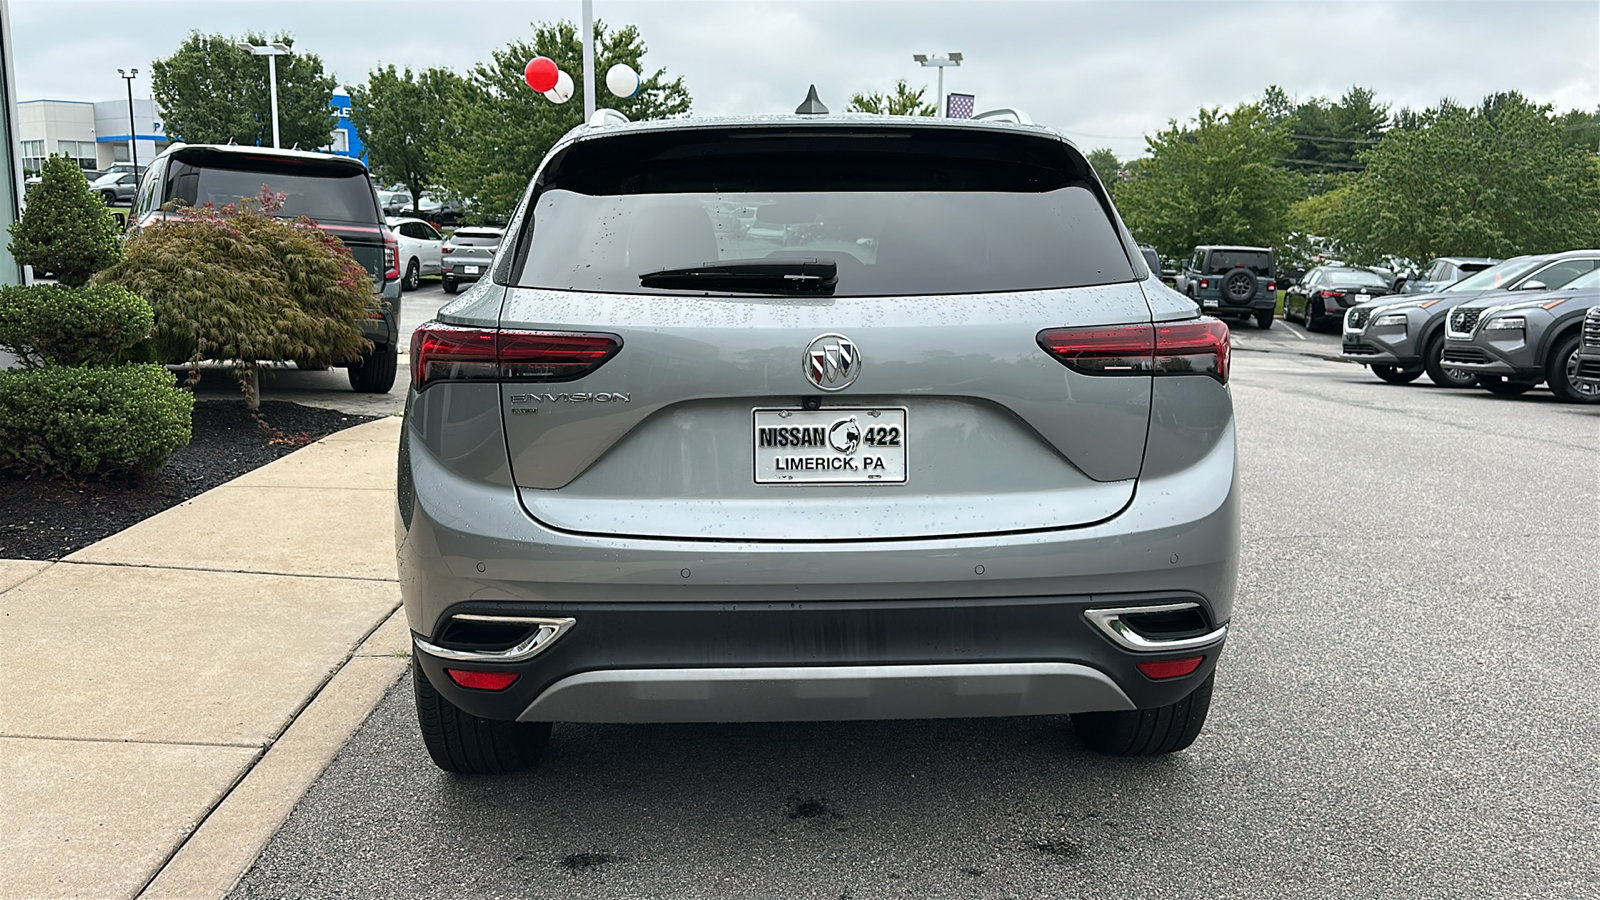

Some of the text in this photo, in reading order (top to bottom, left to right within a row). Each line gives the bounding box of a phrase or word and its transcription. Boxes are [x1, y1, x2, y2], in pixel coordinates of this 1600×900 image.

[510, 391, 631, 403] ENVISION
[758, 427, 900, 446] NISSAN 422
[776, 457, 885, 471] LIMERICK, PA
